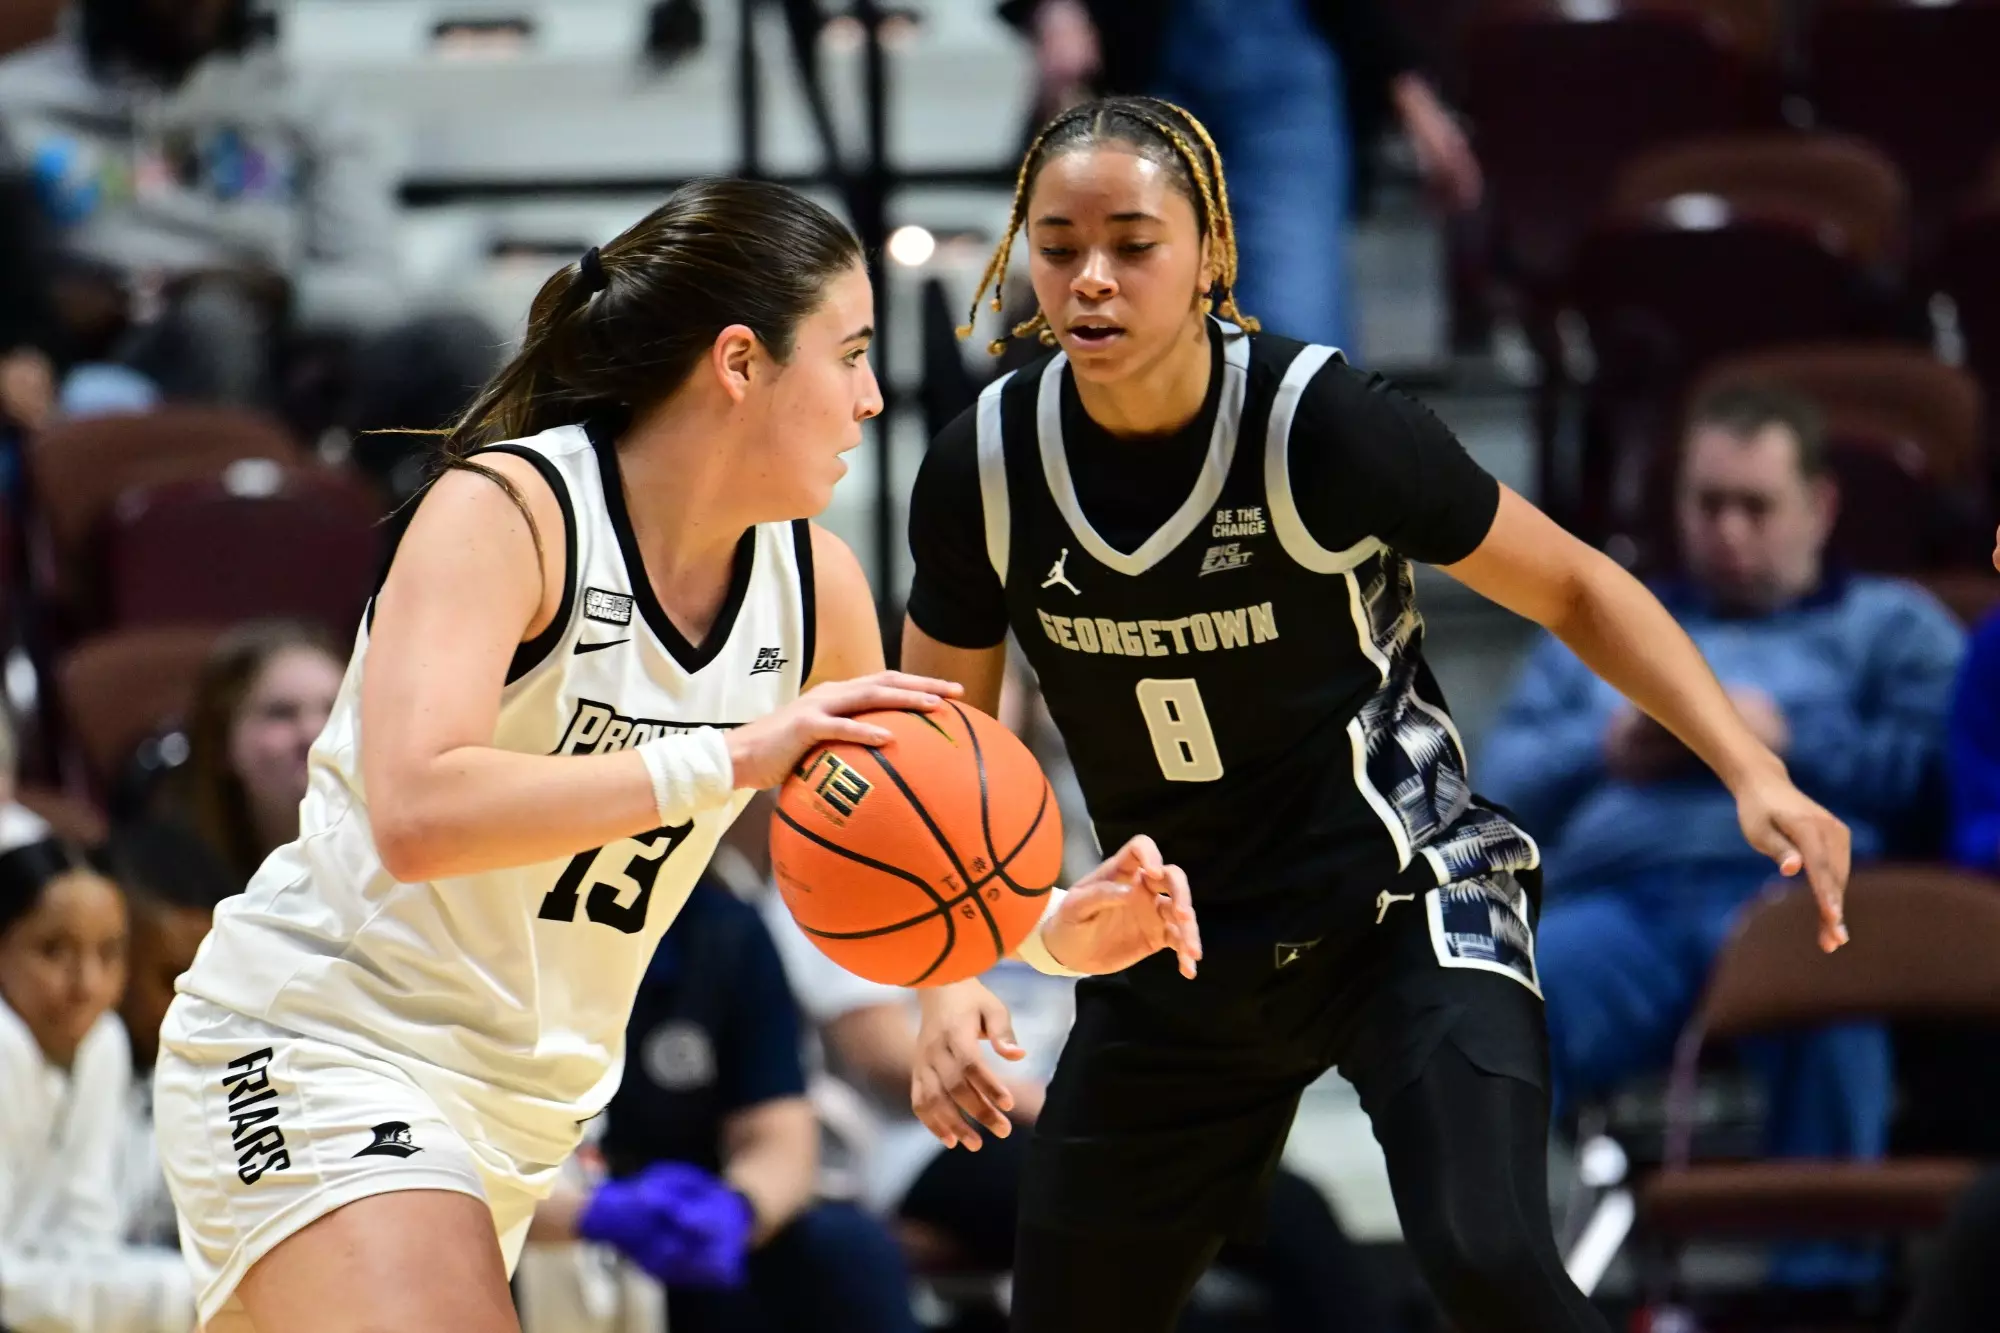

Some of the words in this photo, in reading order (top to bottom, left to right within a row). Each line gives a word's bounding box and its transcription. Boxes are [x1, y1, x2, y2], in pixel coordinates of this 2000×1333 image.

[1216, 509, 1233, 524] BE
[1236, 507, 1263, 522] THE
[1212, 520, 1267, 538] CHANGE
[1205, 543, 1241, 557] BIG
[1200, 551, 1254, 571] EAST
[1036, 601, 1279, 657] GEORGETOWN
[757, 647, 781, 659] BIG
[752, 658, 789, 670] EAST
[1135, 677, 1224, 783] 8
[537, 816, 695, 934] 13
[222, 1046, 291, 1186] FRIARS
